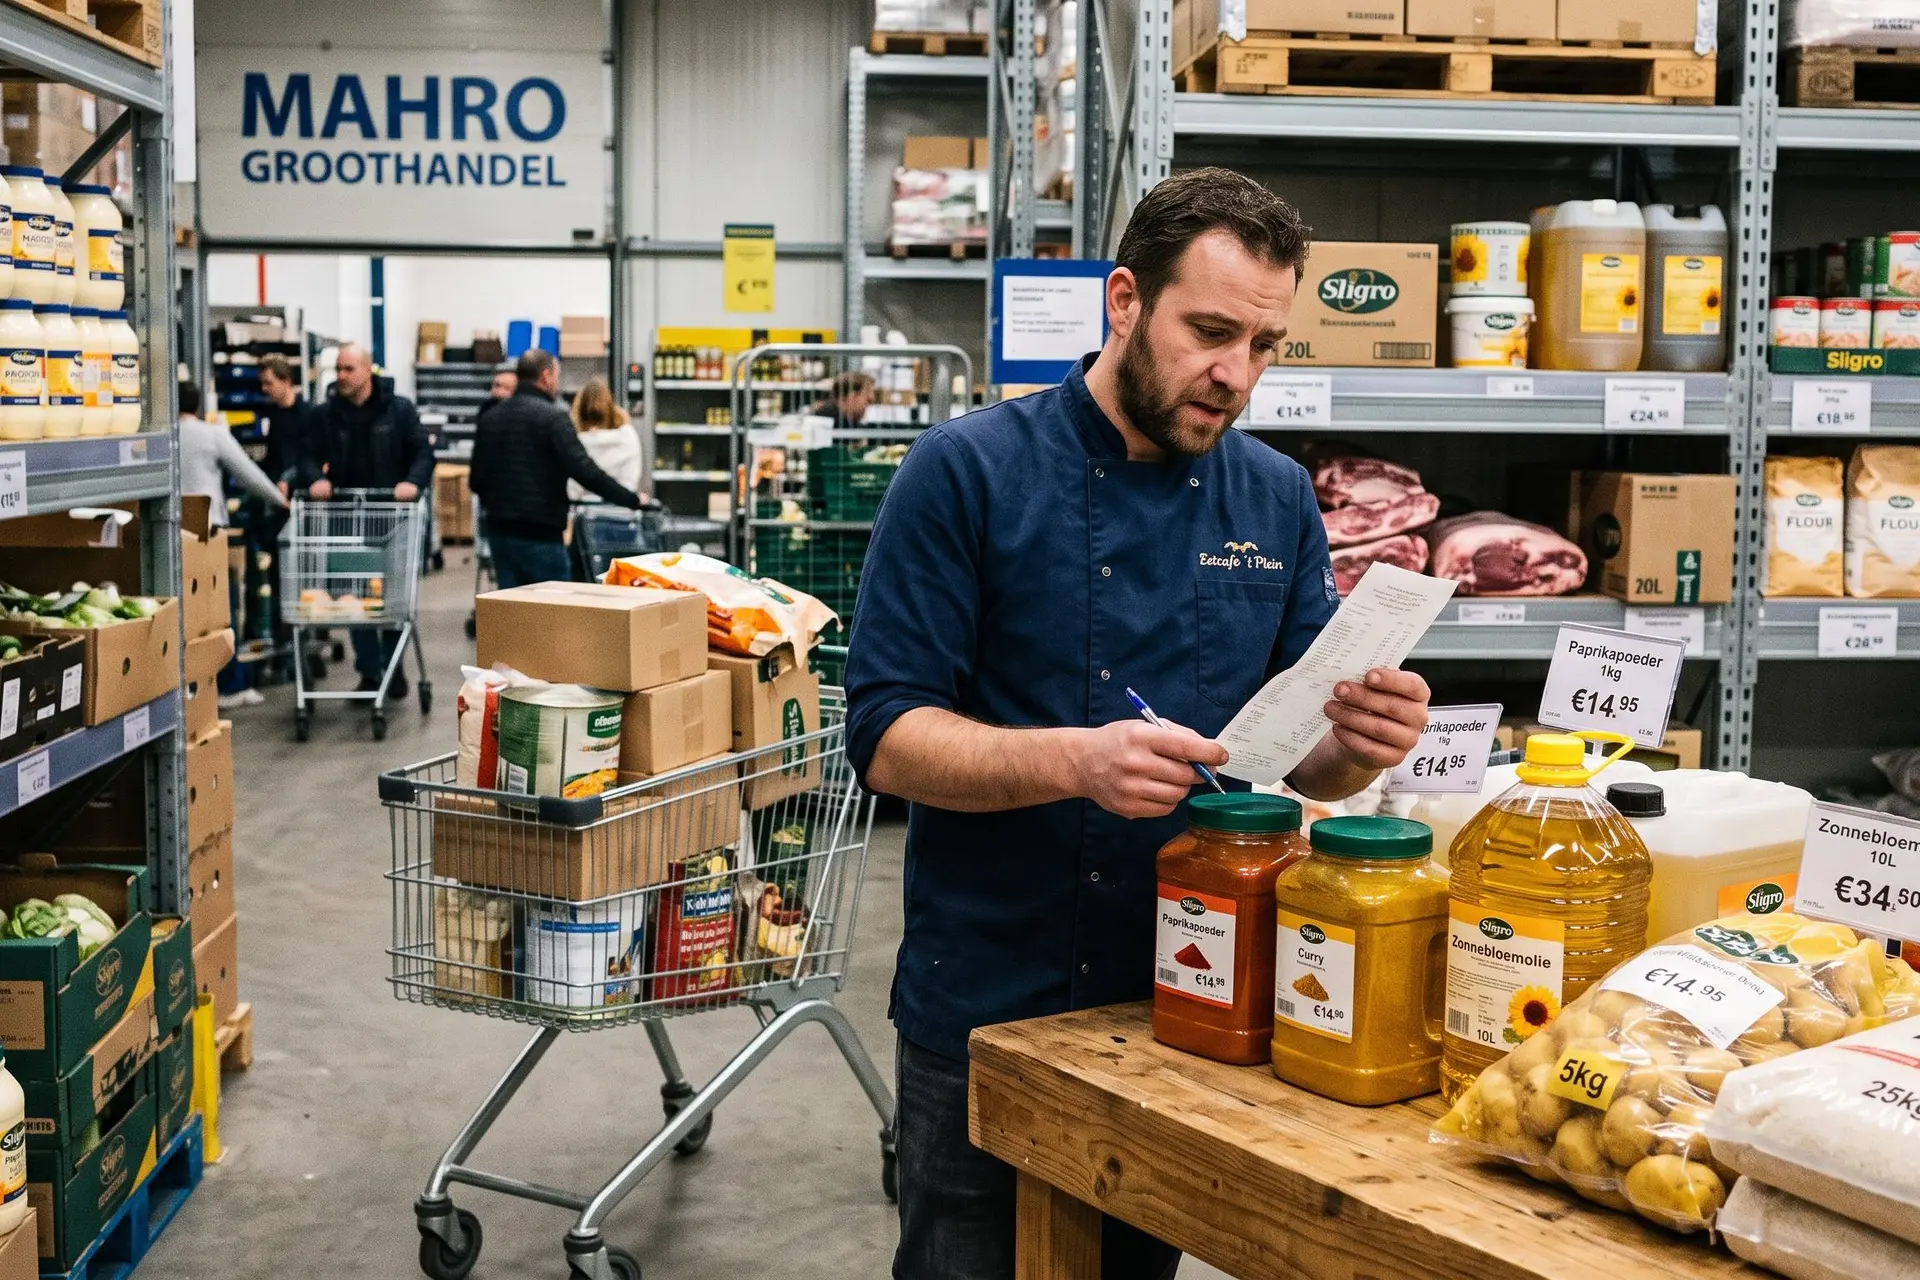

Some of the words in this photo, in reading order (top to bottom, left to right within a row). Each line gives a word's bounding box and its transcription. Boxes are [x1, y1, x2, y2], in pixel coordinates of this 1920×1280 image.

[242, 72, 566, 143] MAHRO
[241, 150, 566, 187] GROOTHANDEL
[1321, 278, 1397, 305] Sligro
[1284, 341, 1316, 359] 20L
[1826, 351, 1884, 372] Sligro
[1786, 516, 1833, 528] FLOUR
[1253, 556, 1284, 570] Plein
[1635, 578, 1663, 595] 20L
[1568, 640, 1664, 668] Paprikapoeder
[1600, 664, 1623, 682] 1kg
[1571, 688, 1640, 719] €14.95
[1421, 719, 1487, 735] prikapoeder
[1438, 736, 1451, 746] 1kg
[1412, 754, 1467, 777] €14.95
[1869, 850, 1897, 868] 10L
[1747, 892, 1783, 912] Sligro
[1162, 912, 1226, 938] Paprikapoeder
[1298, 947, 1324, 965] Curry
[1452, 934, 1552, 969] Zonnebloemolie
[1644, 967, 1728, 1002] €14.95
[1477, 1028, 1496, 1044] 10L
[1559, 1058, 1608, 1099] 5kg
